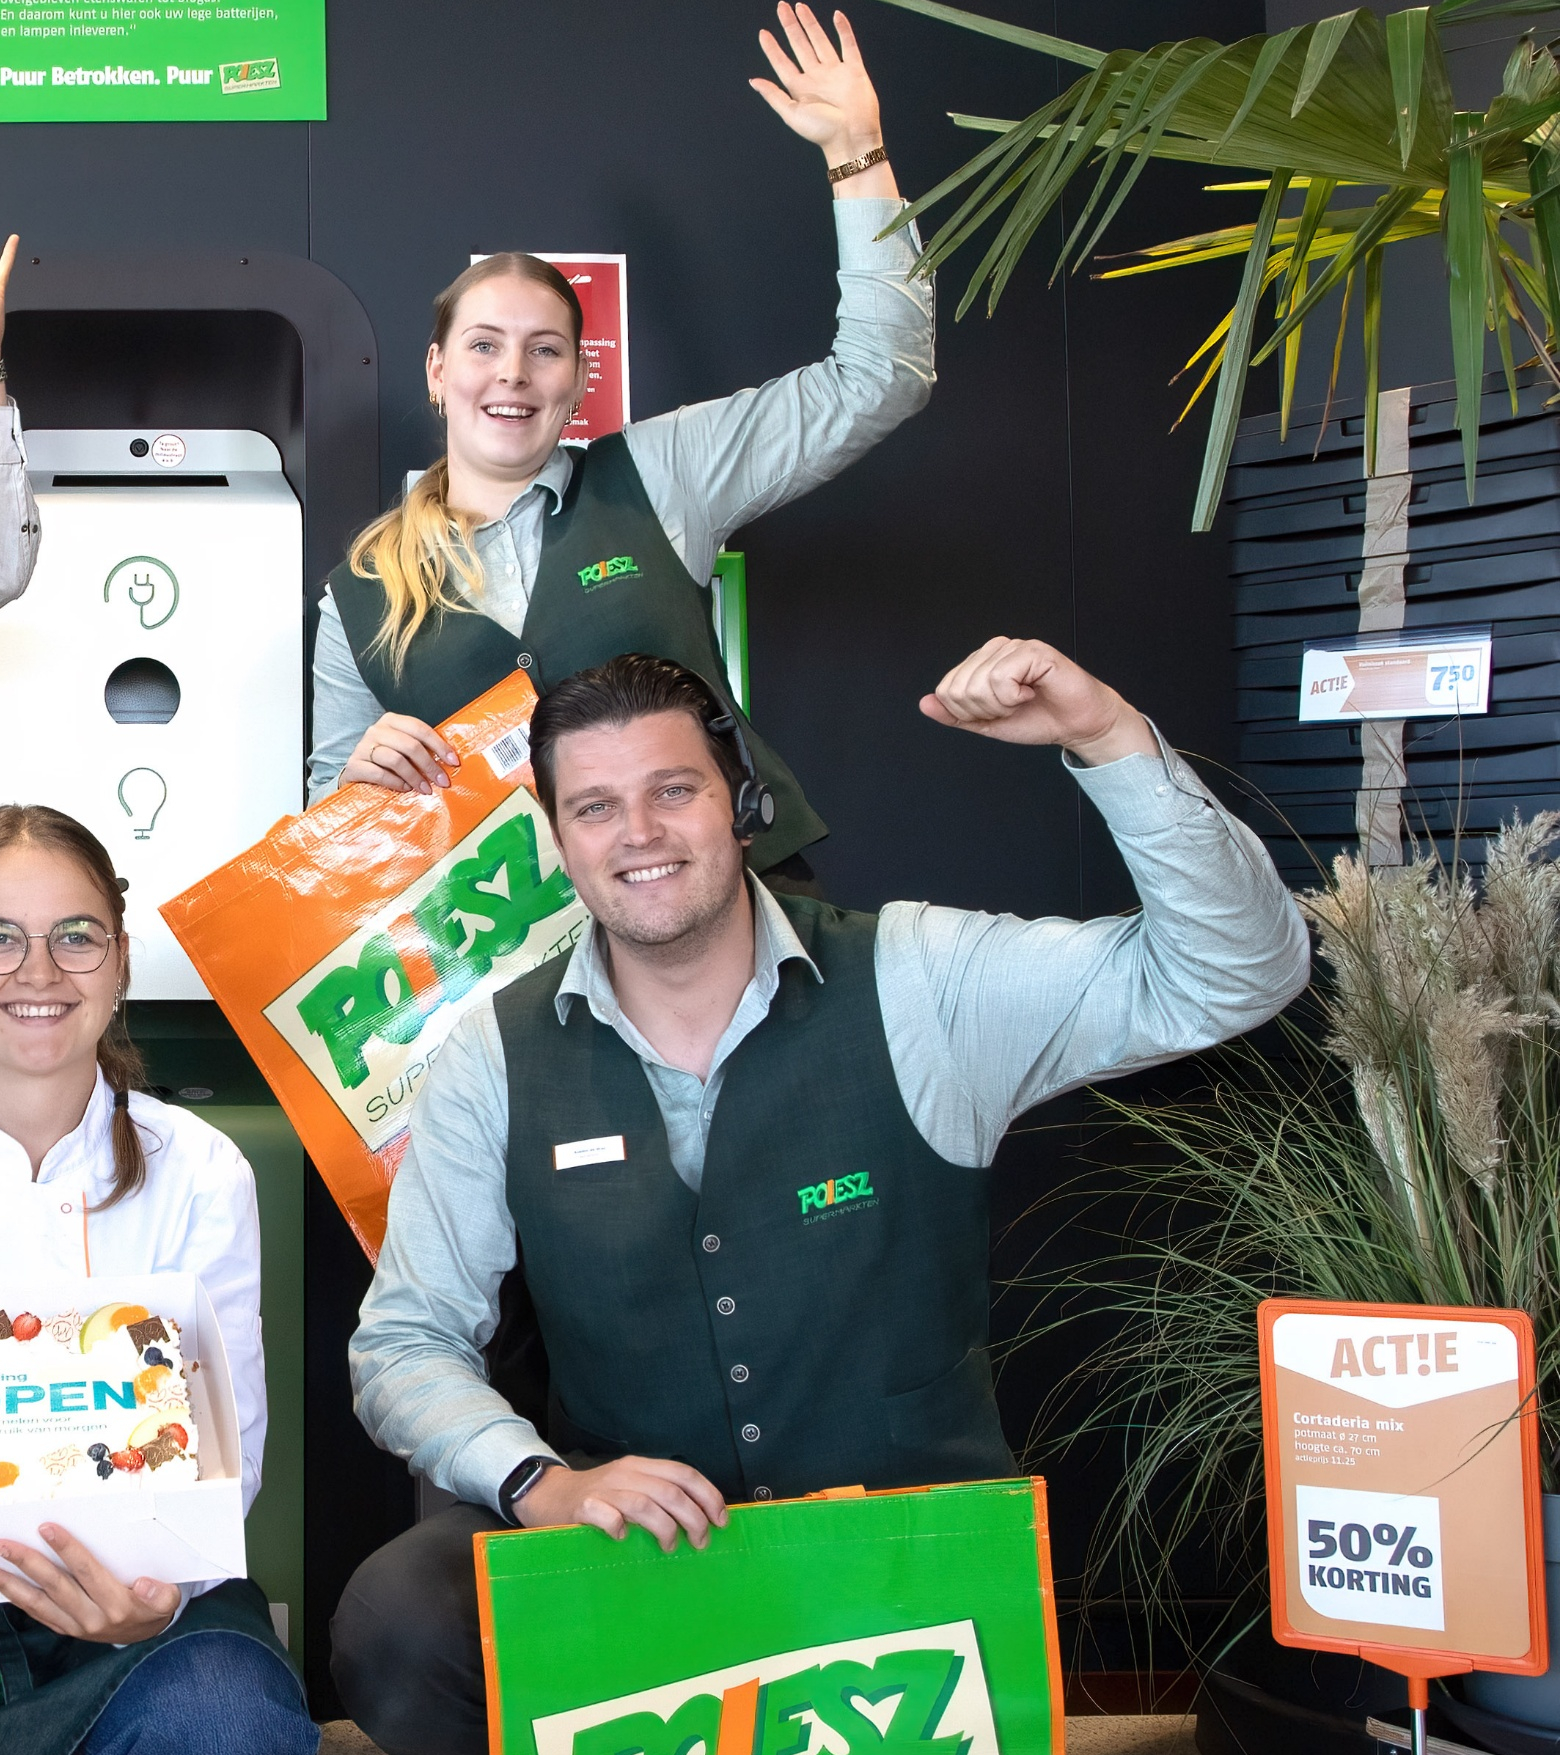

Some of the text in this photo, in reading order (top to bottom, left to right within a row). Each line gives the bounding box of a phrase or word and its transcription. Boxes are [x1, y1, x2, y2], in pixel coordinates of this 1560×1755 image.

[0, 7, 278, 21] En daarom kunt u hier ook uw lege batterijen,
[1, 27, 16, 36] en
[20, 25, 65, 39] lampen
[0, 67, 46, 86] Puur
[51, 65, 161, 86] Betrokken.
[166, 65, 213, 85] Puur
[297, 813, 576, 1090] POIESZ
[797, 1171, 874, 1215] POIESZ
[1293, 1412, 1404, 1432] Cortaderia mix
[1294, 1429, 1336, 1440] potmaat
[1348, 1434, 1359, 1443] 27
[1362, 1434, 1377, 1443] cm
[1295, 1440, 1380, 1456] hoogte ca. 70 cm
[1308, 1519, 1434, 1569] 50%
[1308, 1564, 1432, 1599] KORTING
